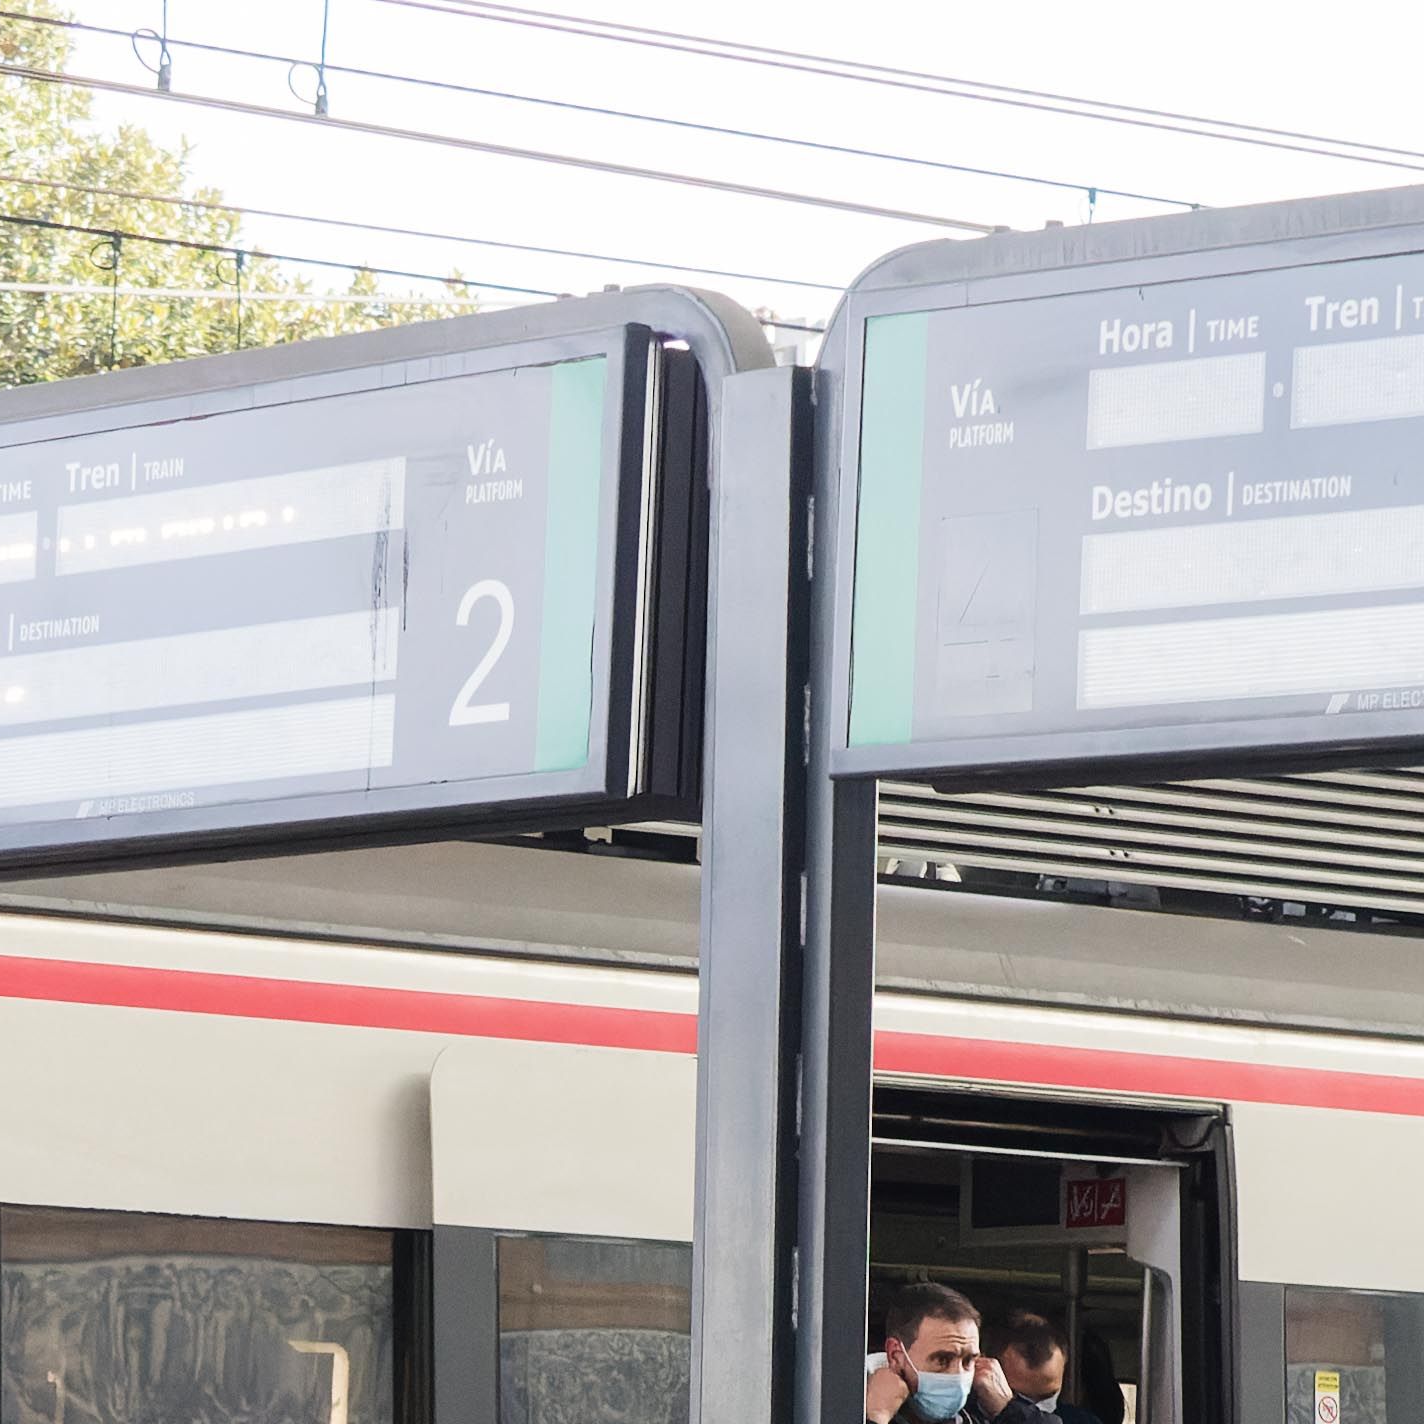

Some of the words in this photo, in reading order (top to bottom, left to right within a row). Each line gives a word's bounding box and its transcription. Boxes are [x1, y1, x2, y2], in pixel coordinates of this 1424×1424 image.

[1305, 295, 1378, 331] Tren
[1099, 319, 1174, 354] Hora
[1206, 315, 1259, 342] TIME
[949, 421, 1015, 449] PLATFORM
[65, 461, 120, 492] Tren
[144, 457, 185, 481] TRAIN
[465, 479, 523, 504] PLATFORM
[1091, 478, 1212, 521] Destino
[1242, 475, 1352, 506] DESTINATION
[19, 614, 100, 642] DESTINATION
[448, 579, 515, 726] 2
